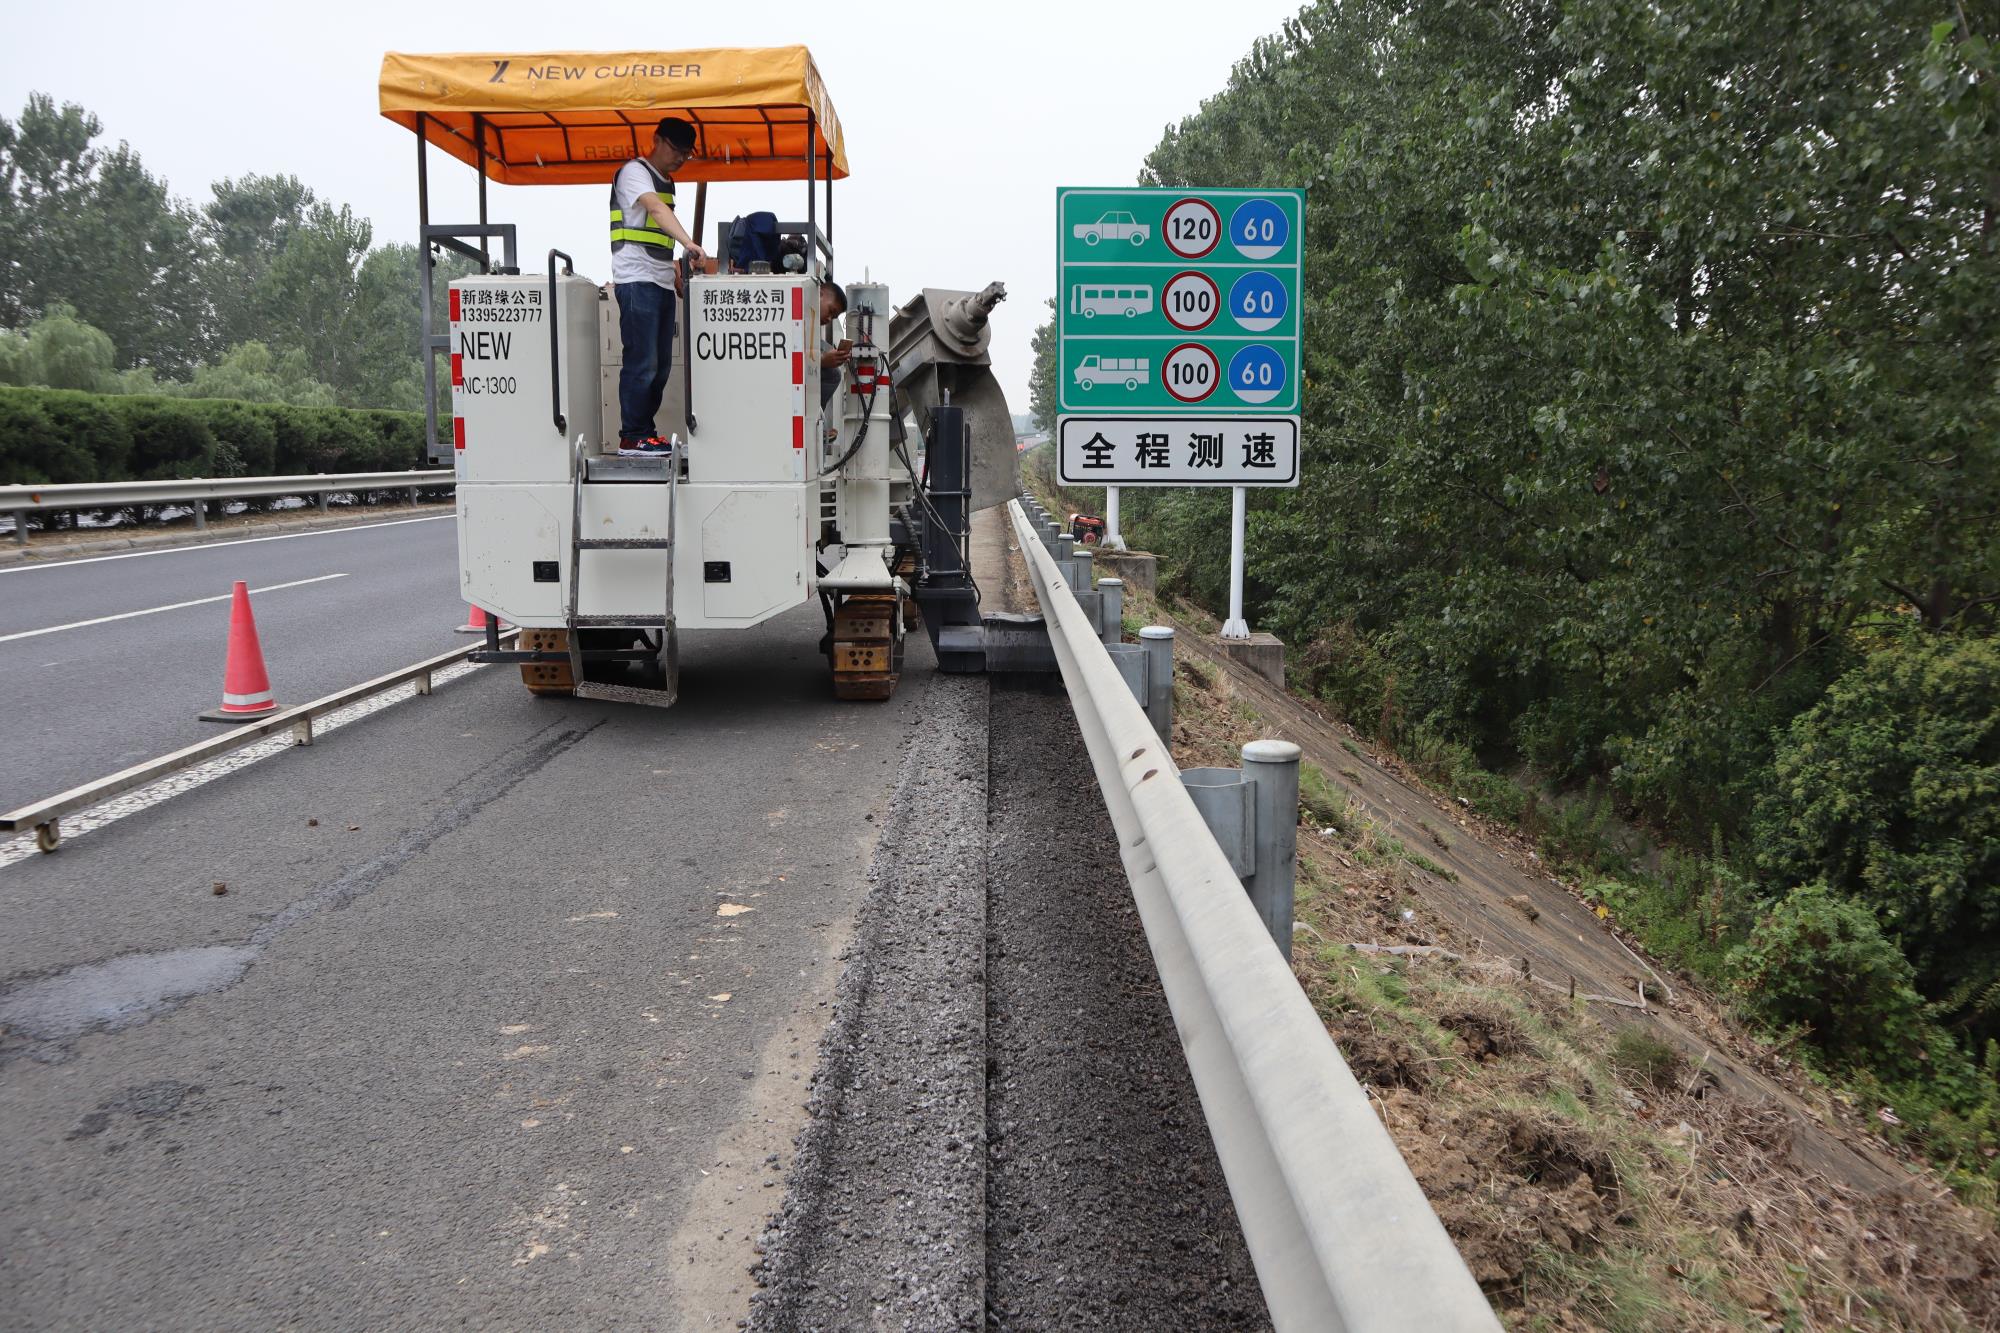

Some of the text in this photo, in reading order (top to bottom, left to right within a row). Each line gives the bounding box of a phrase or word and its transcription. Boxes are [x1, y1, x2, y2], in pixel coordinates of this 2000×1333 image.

[527, 64, 701, 80] NEW CURBER
[1172, 217, 1274, 241] 120 60
[461, 289, 542, 305] 新路缘公司
[703, 289, 785, 305] 新路缘公司
[1173, 290, 1274, 313] 100 60
[461, 308, 542, 322] 13395223777
[703, 307, 785, 322] 13395223777
[461, 332, 512, 360] NEW
[697, 332, 787, 360] CURBER
[1172, 362, 1272, 385] 100 60
[462, 377, 517, 394] NC-1300
[1081, 432, 1277, 469] 全程测速
